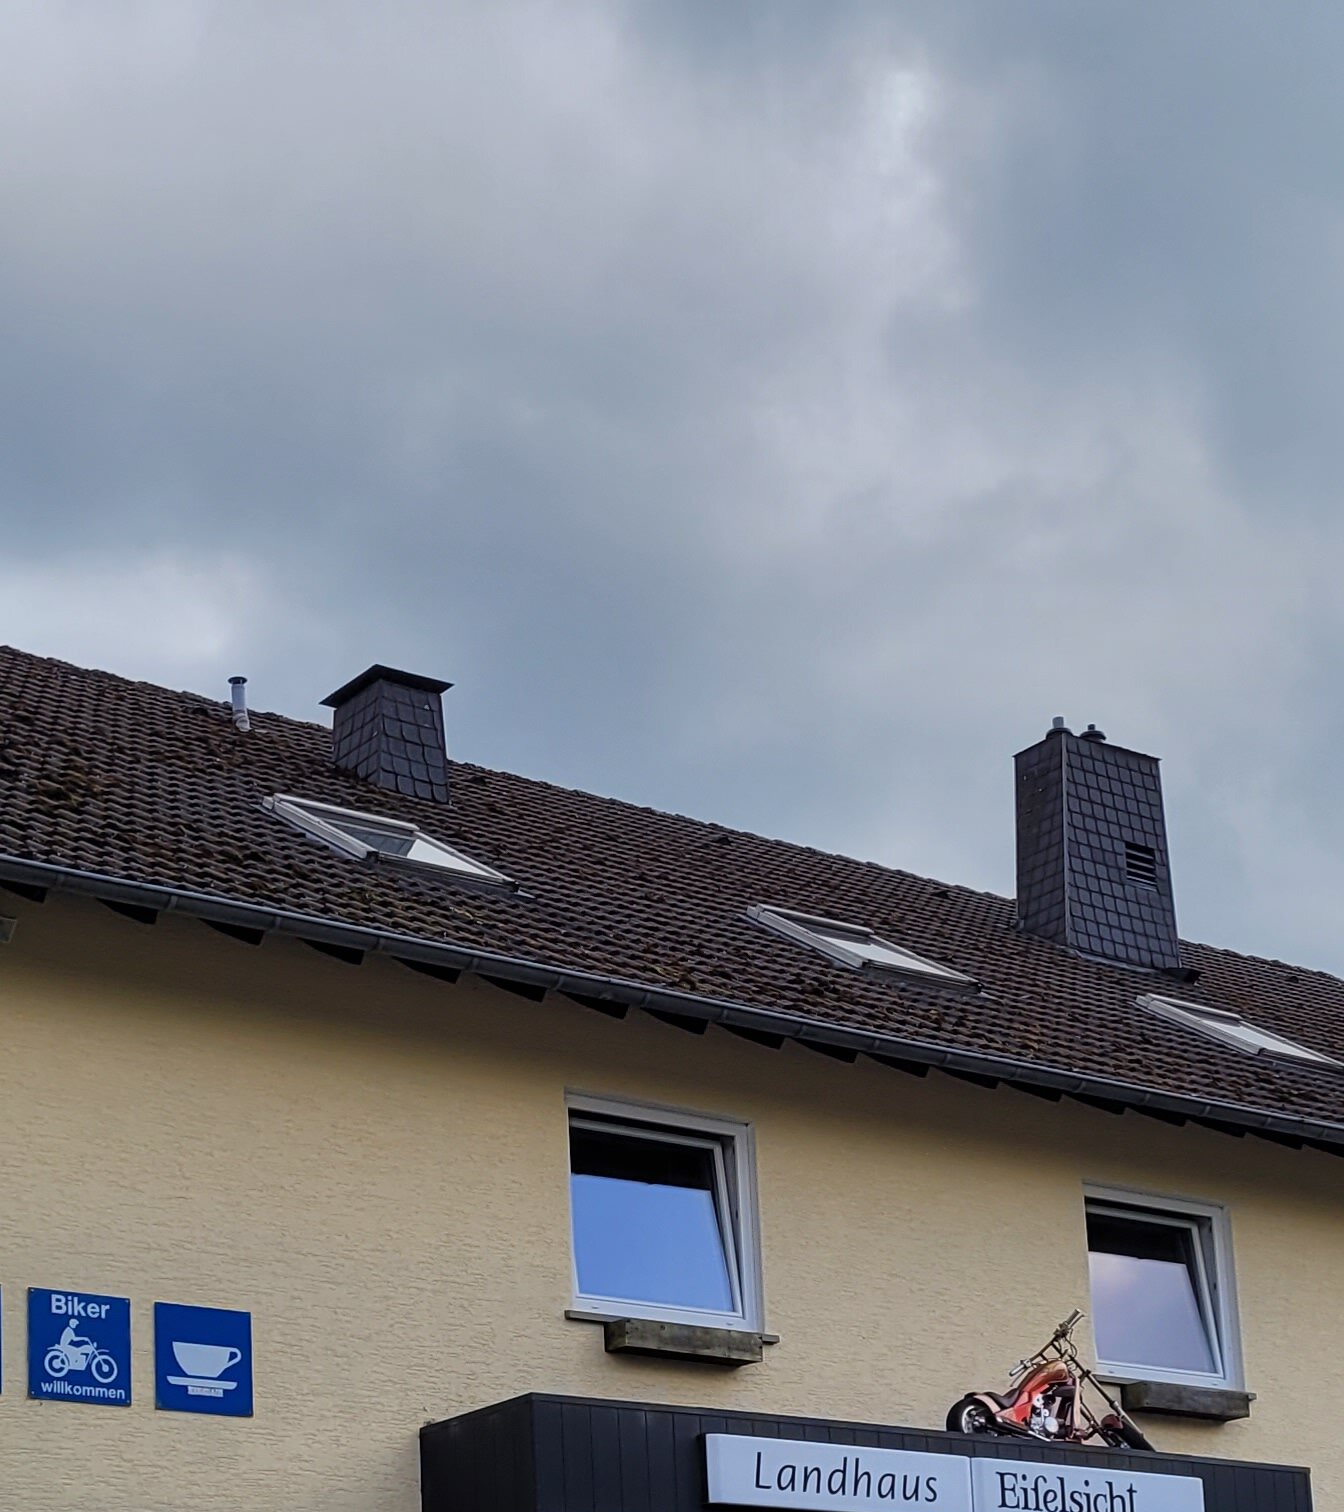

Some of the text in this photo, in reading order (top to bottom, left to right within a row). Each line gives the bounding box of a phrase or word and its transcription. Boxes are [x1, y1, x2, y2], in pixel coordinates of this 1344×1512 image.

[50, 1294, 110, 1319] Biker
[41, 1380, 125, 1400] willkommen
[754, 1451, 938, 1503] Landhaus
